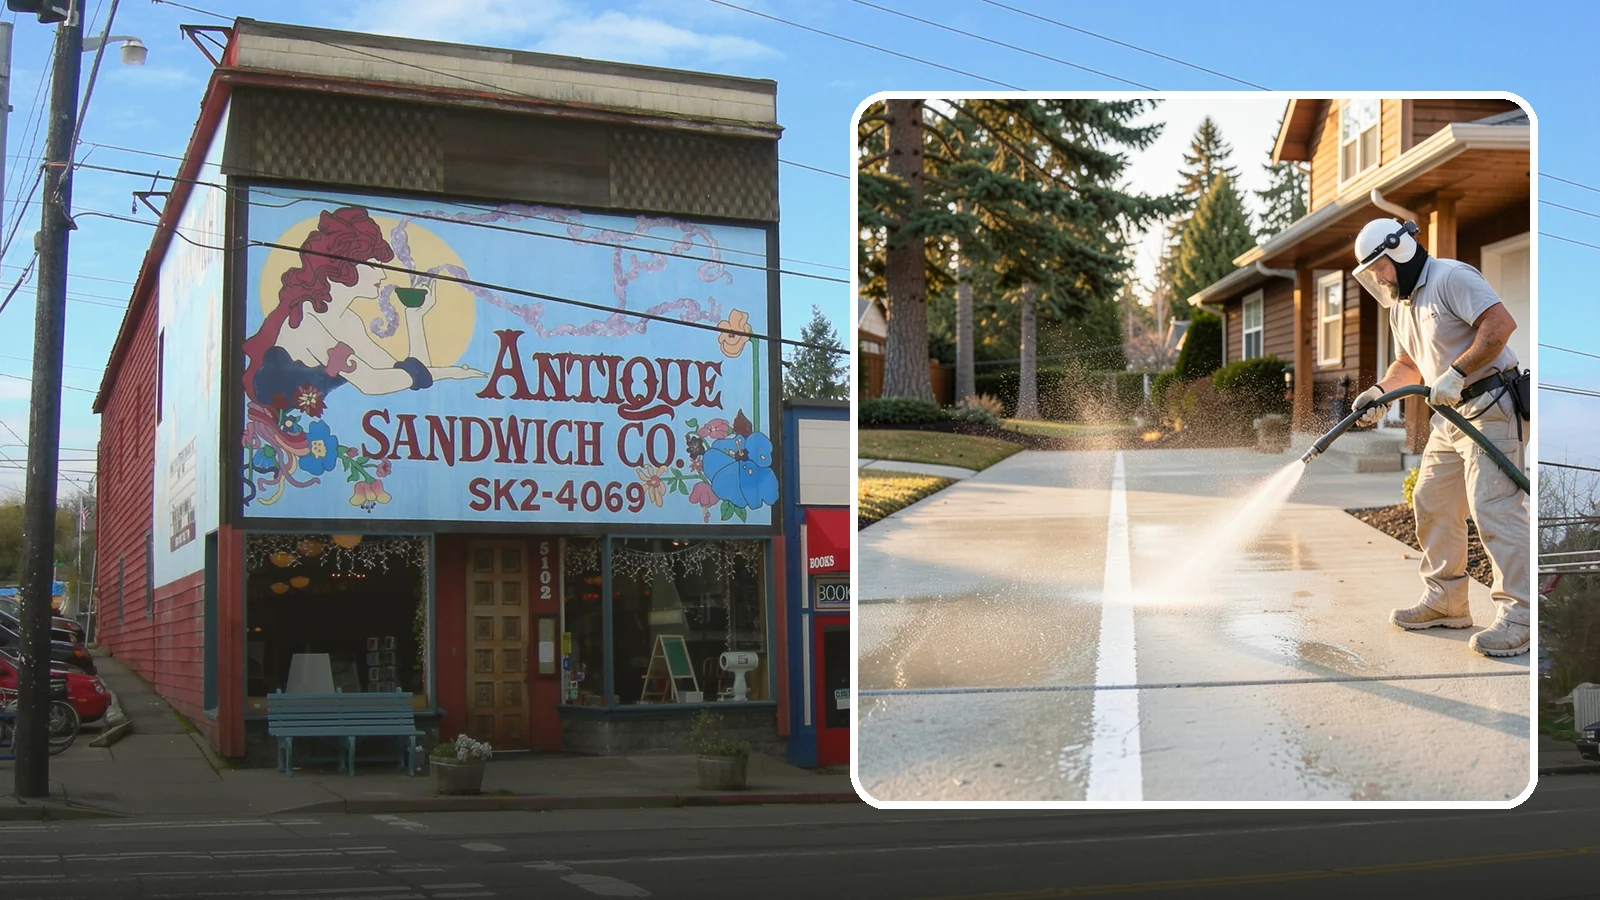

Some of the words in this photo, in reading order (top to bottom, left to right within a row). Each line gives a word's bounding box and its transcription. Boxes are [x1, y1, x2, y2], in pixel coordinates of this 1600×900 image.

[475, 329, 723, 420] ANTIQUE
[361, 408, 604, 467] SANDWICH
[617, 422, 684, 468] CO.
[468, 477, 645, 512] SK2-4069
[539, 541, 552, 600] 5102
[809, 555, 835, 569] BOOKS
